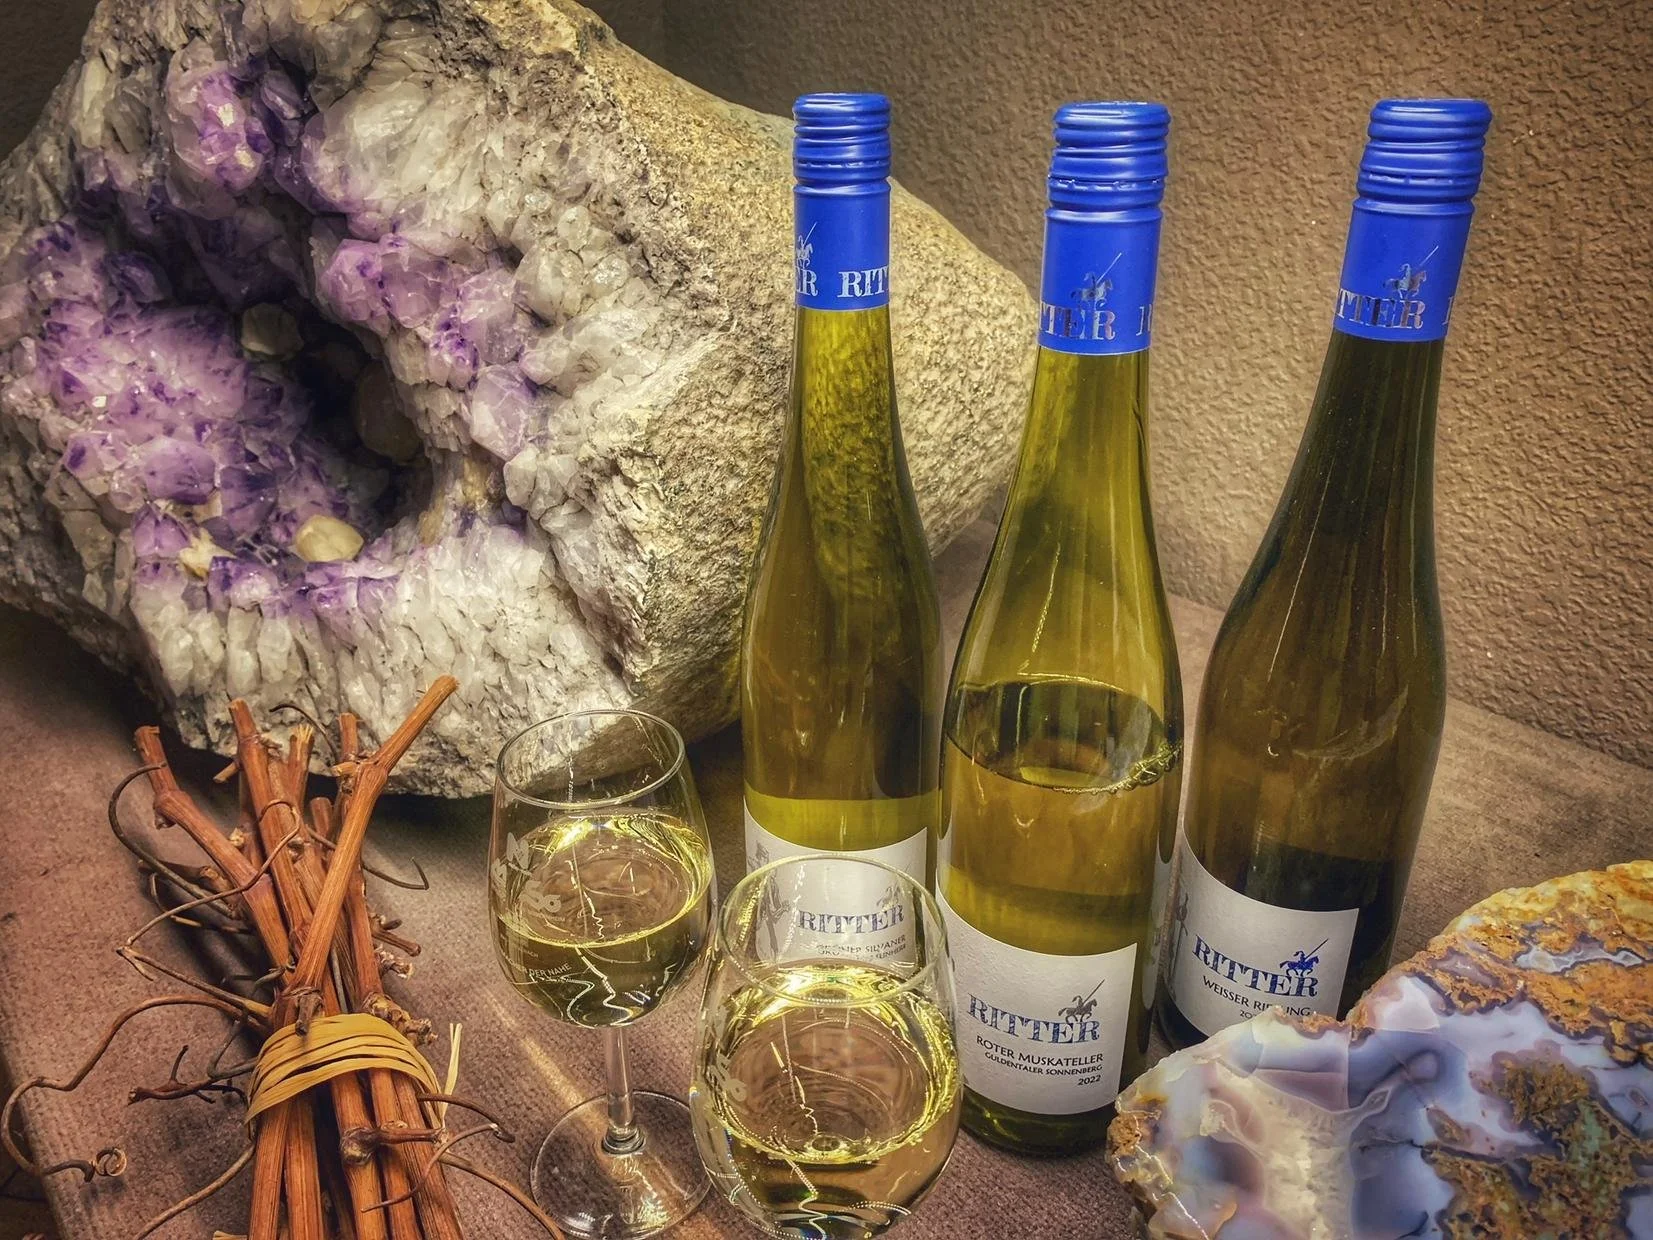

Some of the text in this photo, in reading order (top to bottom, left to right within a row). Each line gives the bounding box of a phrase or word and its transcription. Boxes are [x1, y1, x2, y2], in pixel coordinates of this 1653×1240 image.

[798, 904, 904, 934] RITTER
[548, 962, 572, 976] NAHE
[1192, 934, 1318, 997] RITTER
[1203, 975, 1311, 1016] WEISSER RIING
[967, 993, 1100, 1044] RITTER
[976, 1035, 1103, 1066] ROTER MUSKATELLER
[985, 1051, 1103, 1075] GULDENTALER SONNENBERG
[1077, 1074, 1101, 1086] 2022
